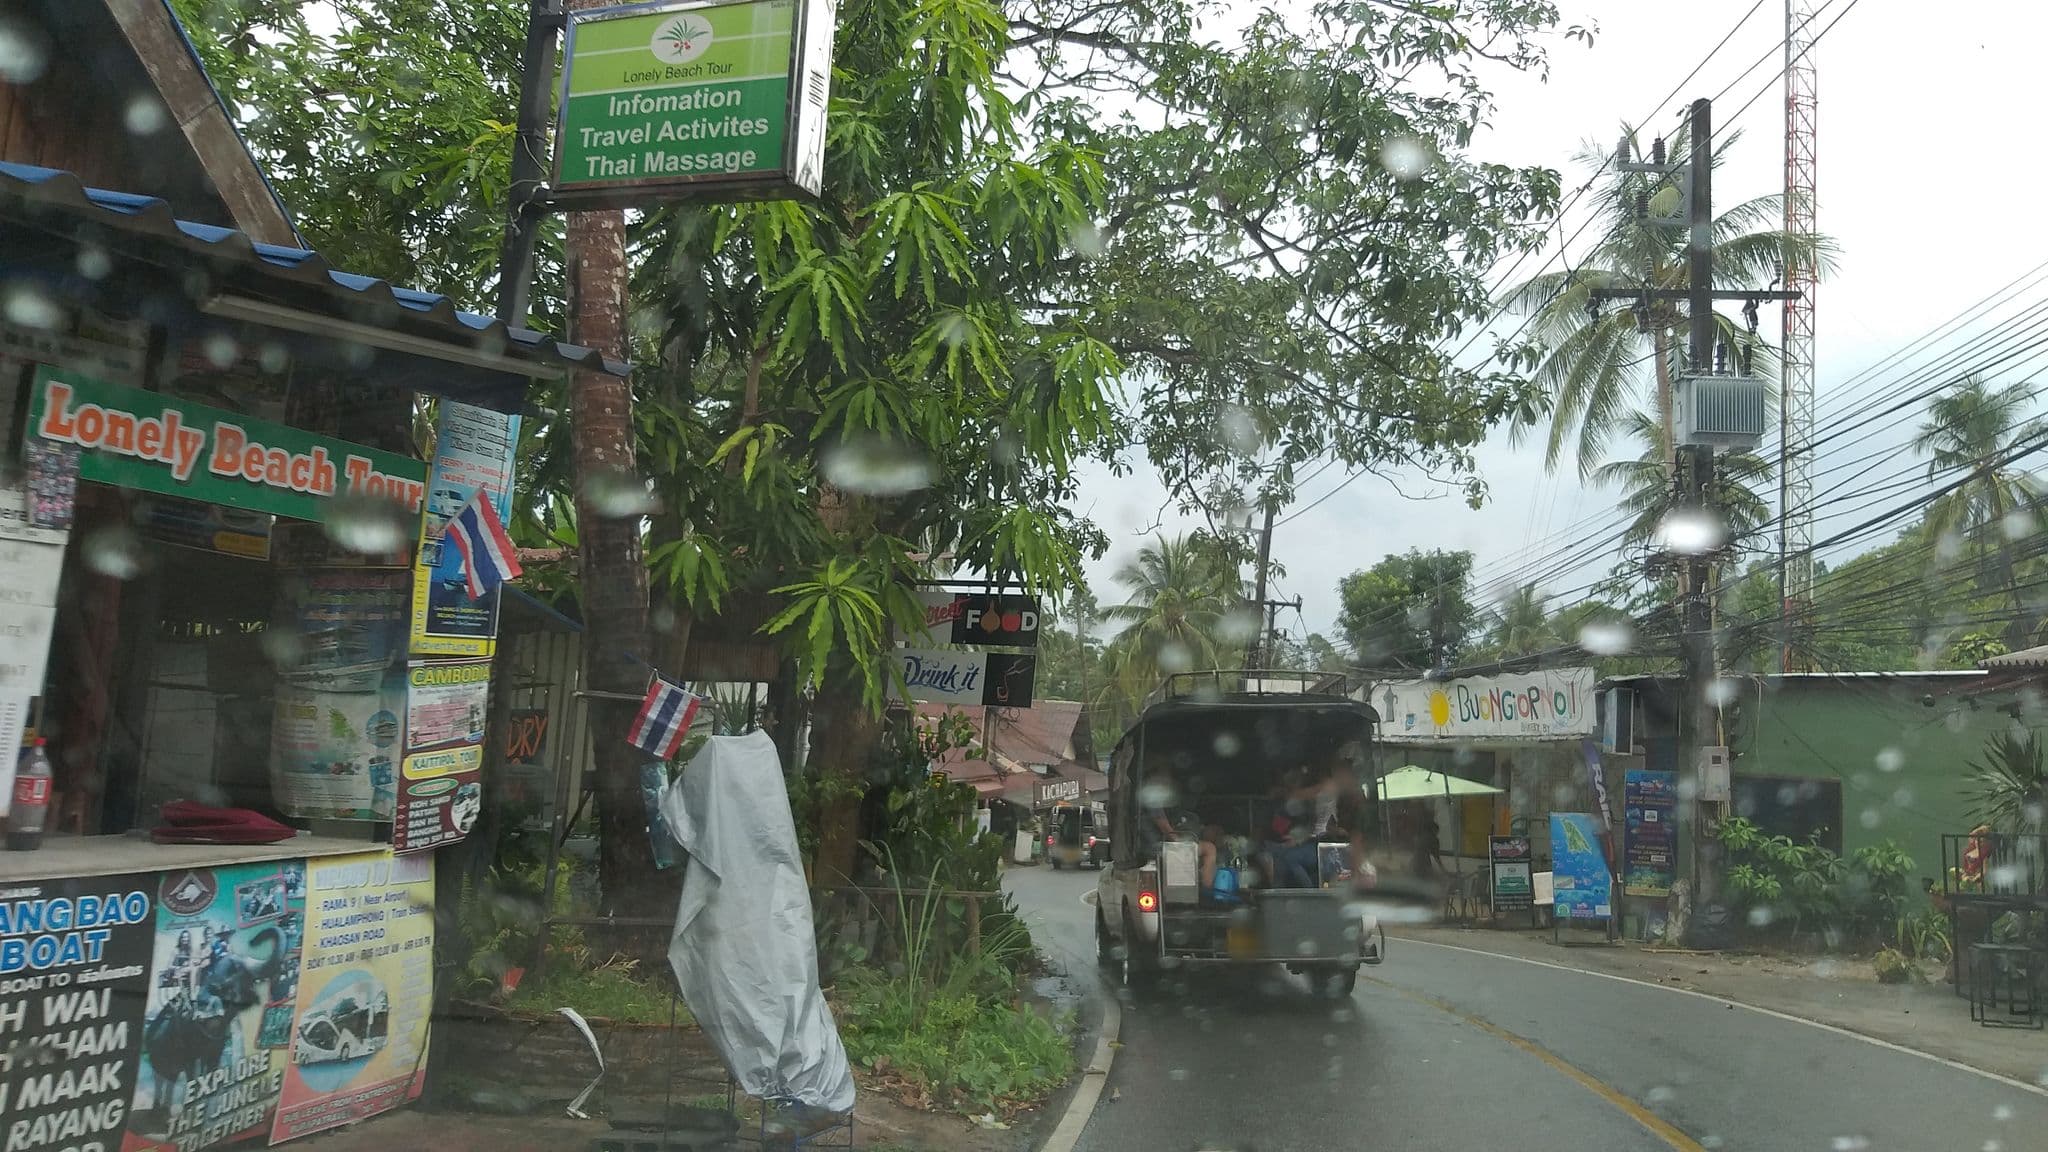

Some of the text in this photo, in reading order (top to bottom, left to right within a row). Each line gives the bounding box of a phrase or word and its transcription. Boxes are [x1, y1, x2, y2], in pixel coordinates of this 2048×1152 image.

[623, 62, 733, 83] Lonely Beach Tour
[608, 87, 742, 117] Infomation
[579, 115, 769, 149] Travel Activites
[585, 148, 757, 178] Thai Massage
[38, 380, 424, 514] Lonely Beach Tour
[410, 664, 490, 688] CAMBODIA
[903, 655, 980, 691] Drink it
[322, 898, 348, 912] RAMA
[0, 928, 112, 974] BOAT
[319, 927, 386, 948] KHAOSAN ROAD
[0, 972, 71, 995] BOAT TO
[43, 987, 112, 1027] WAI
[15, 1060, 124, 1111] MAAK
[184, 1049, 270, 1105] EXPLORE
[167, 1069, 281, 1138] THE JUNGLE
[5, 1098, 125, 1152] RAYANG
[177, 1104, 265, 1152] TOGETHER
